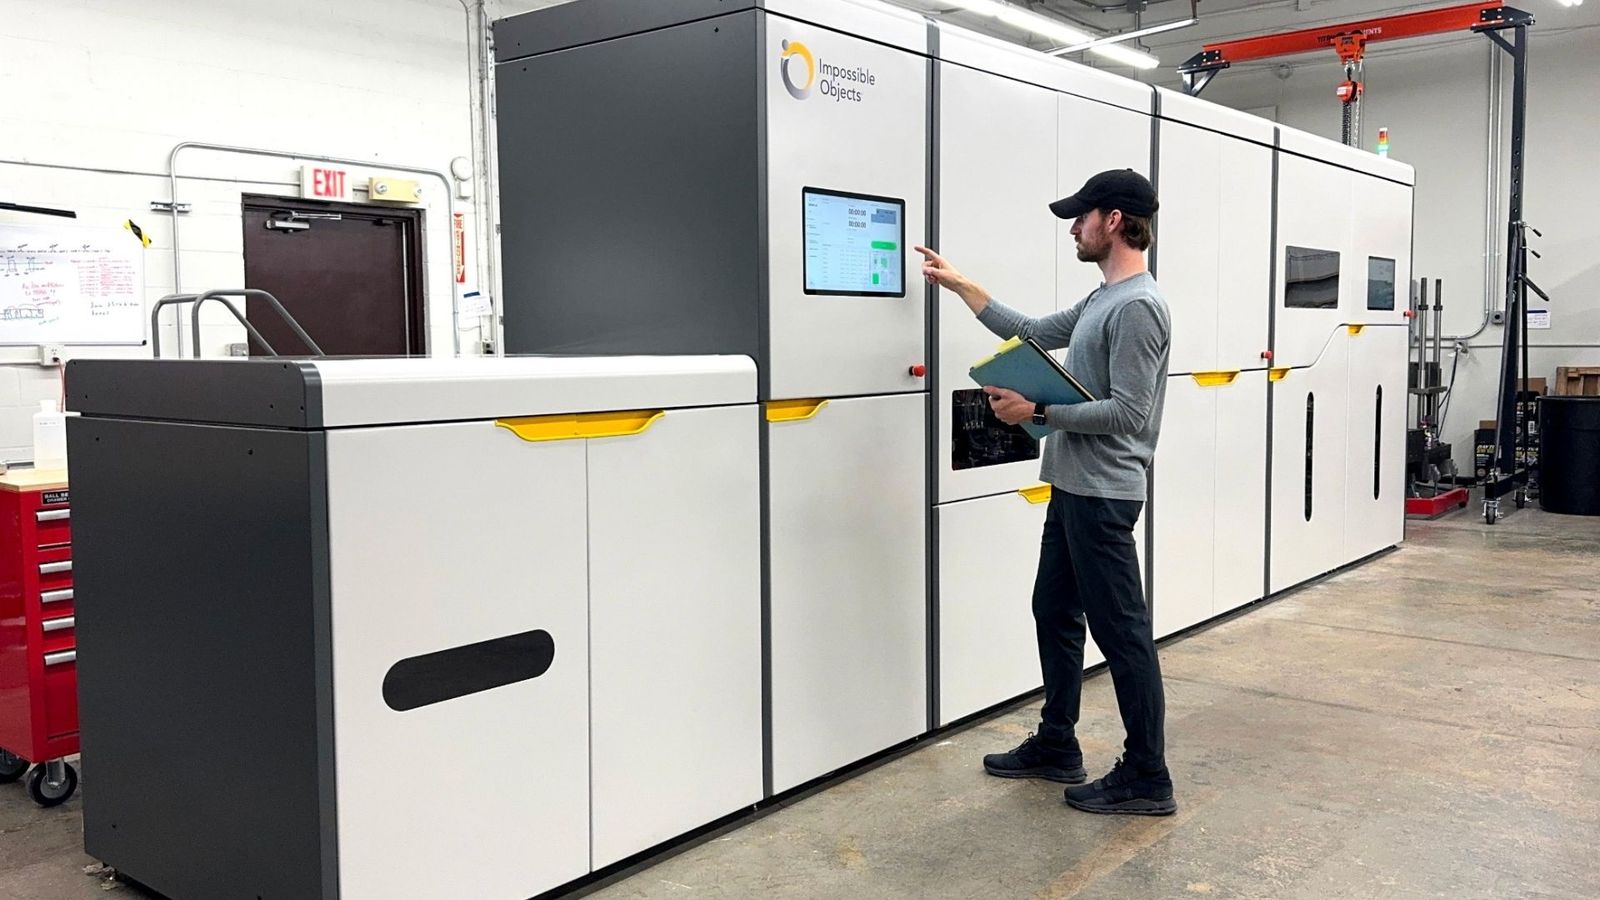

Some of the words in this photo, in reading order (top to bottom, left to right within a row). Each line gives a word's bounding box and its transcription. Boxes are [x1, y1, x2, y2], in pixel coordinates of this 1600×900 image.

[819, 58, 876, 86] Impossible
[820, 79, 862, 102] Objects
[313, 169, 346, 198] EXIT
